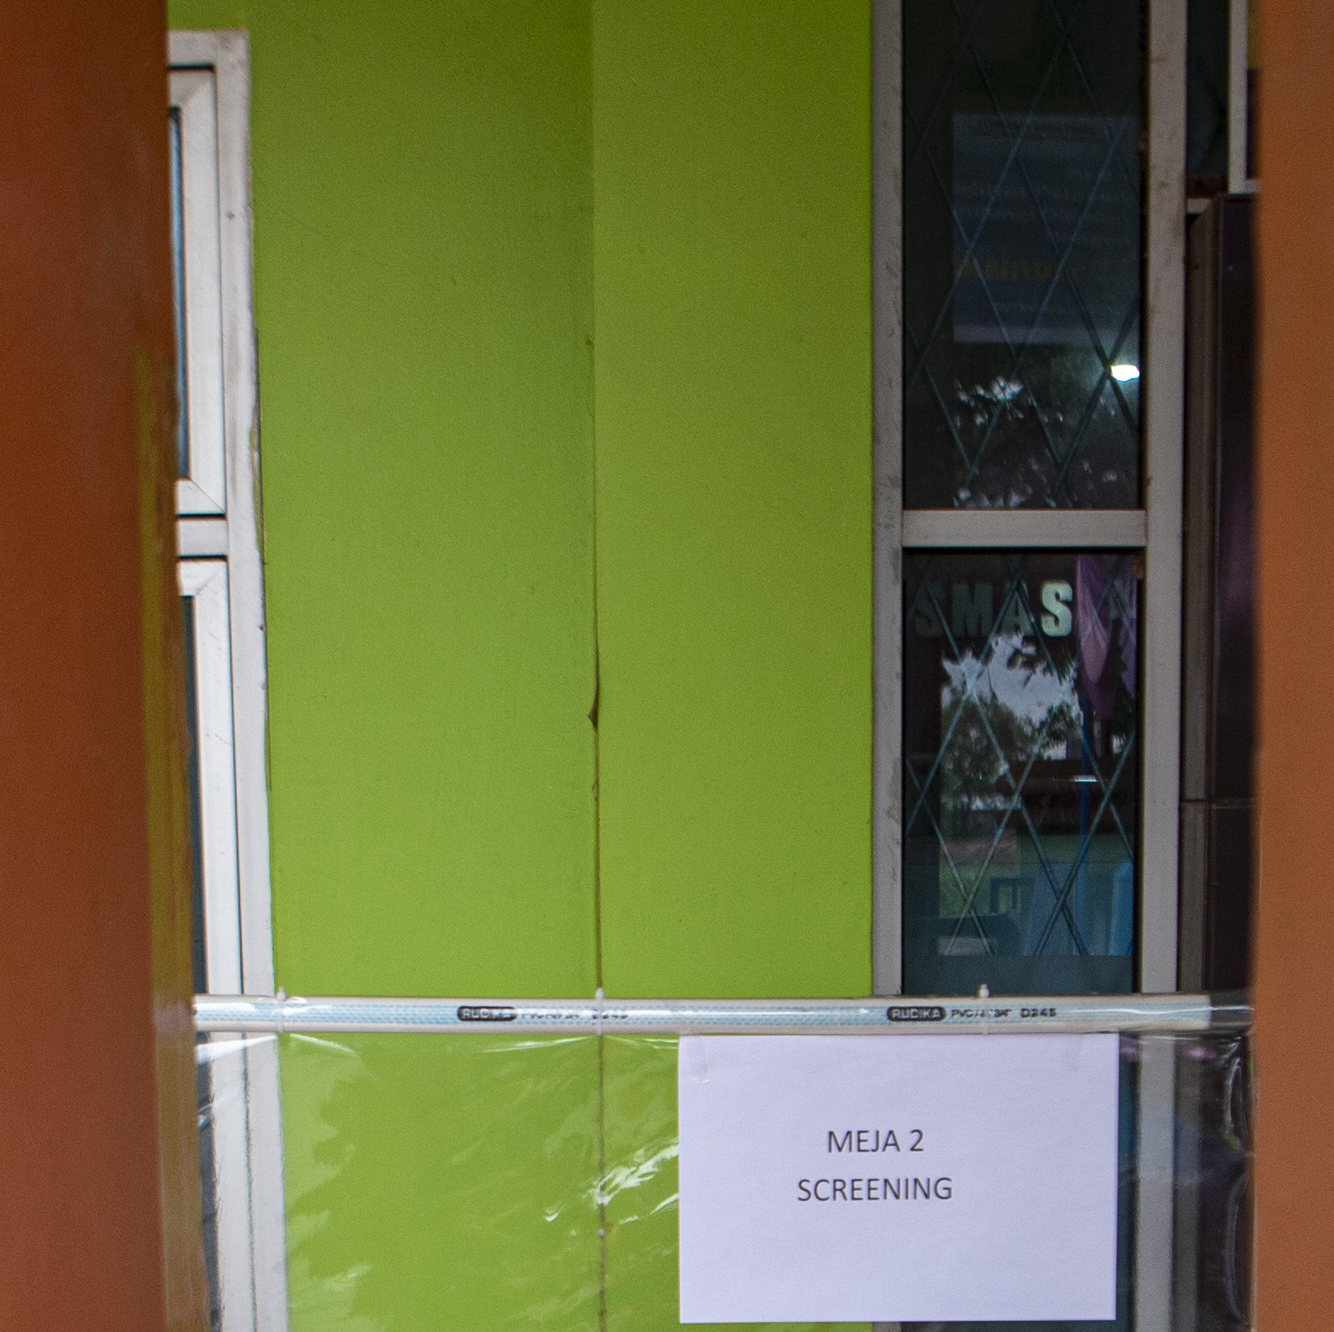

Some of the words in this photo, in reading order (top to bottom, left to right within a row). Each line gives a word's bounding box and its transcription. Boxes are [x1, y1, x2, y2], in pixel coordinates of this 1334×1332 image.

[890, 1007, 943, 1020] RUCIKA
[827, 1129, 901, 1153] MEJA
[910, 1129, 925, 1152] 2
[797, 1177, 953, 1202] SCREENING
